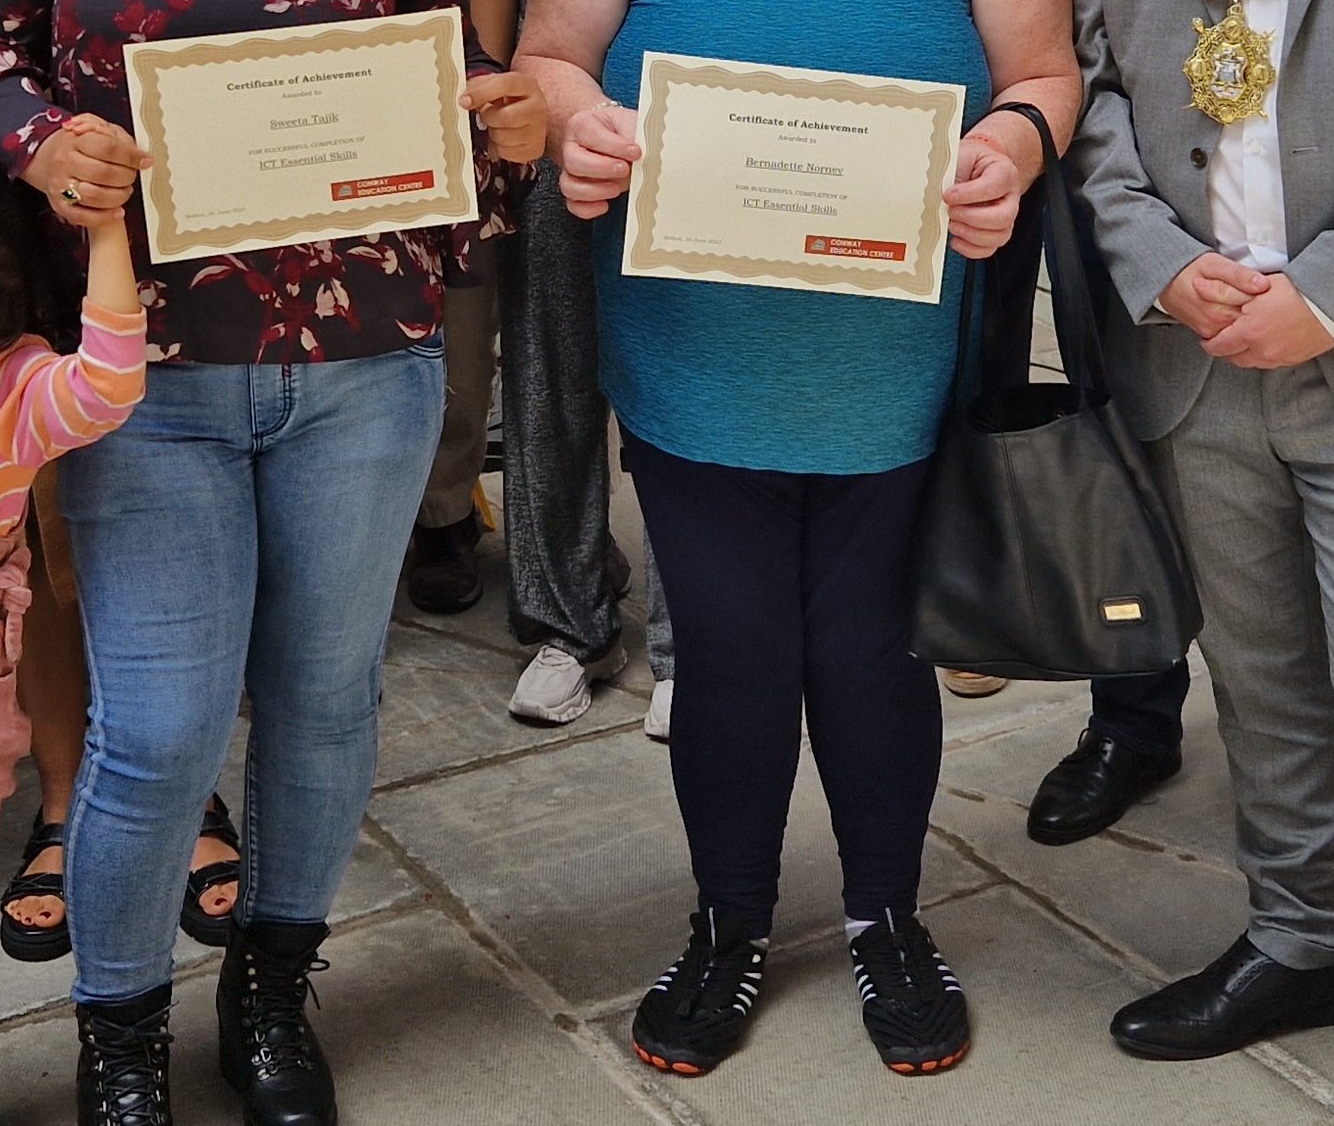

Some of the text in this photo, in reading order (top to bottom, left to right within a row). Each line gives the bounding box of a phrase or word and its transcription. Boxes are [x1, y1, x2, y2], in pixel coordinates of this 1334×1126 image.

[227, 68, 373, 91] Certificate of Achievement
[270, 112, 339, 130] Sweeta Tajik
[729, 113, 869, 134] Certificate of Achievement
[778, 134, 808, 143] Awarded
[260, 151, 358, 170] ICT Essential Skills
[746, 157, 843, 176] Bernadette Norney
[357, 178, 388, 188] CONWAY
[357, 181, 423, 196] EDUCATION CENTRE
[751, 186, 793, 195] SUCCESSFUL
[795, 190, 837, 199] COMPLETION
[742, 197, 837, 216] ICT Essential Skills
[830, 238, 862, 248] CONWAY
[830, 246, 894, 258] EDUCATION CENTRE
